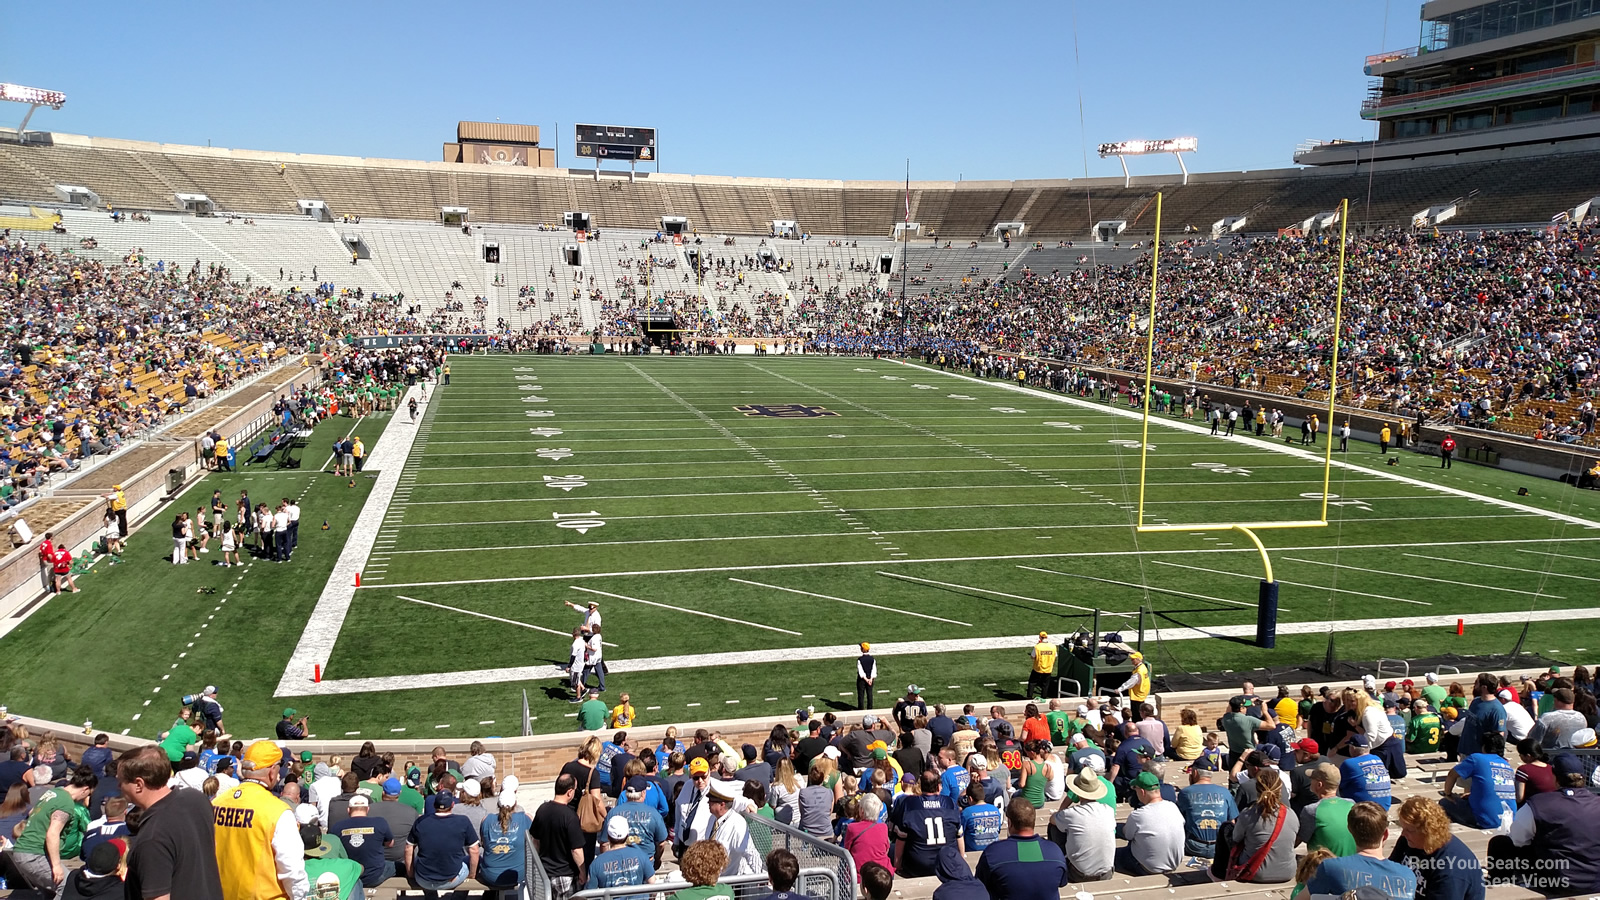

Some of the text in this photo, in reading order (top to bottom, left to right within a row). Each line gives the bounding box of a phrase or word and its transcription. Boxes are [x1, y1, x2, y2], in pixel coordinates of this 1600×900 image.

[363, 338, 377, 346] WE
[553, 511, 606, 528] 10
[904, 705, 920, 719] 10
[1428, 727, 1439, 745] 3
[1002, 750, 1021, 770] 38
[924, 816, 947, 846] 11
